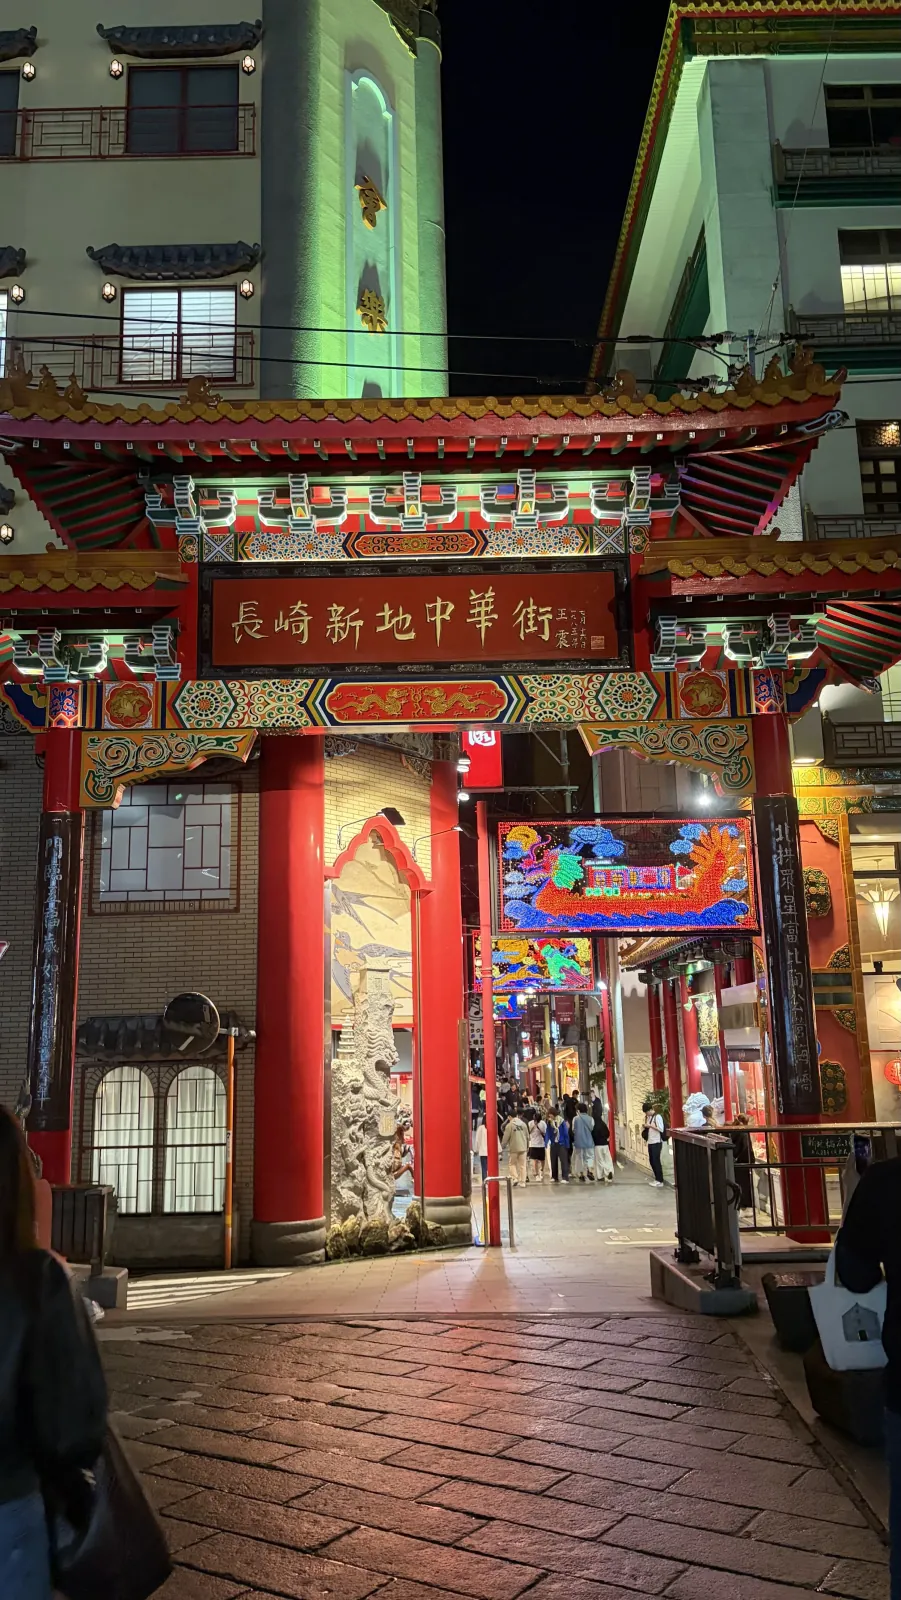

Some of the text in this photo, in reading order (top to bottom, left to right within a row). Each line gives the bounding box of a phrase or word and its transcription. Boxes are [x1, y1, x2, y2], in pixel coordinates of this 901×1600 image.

[232, 586, 552, 651] 長崎新地中華街
